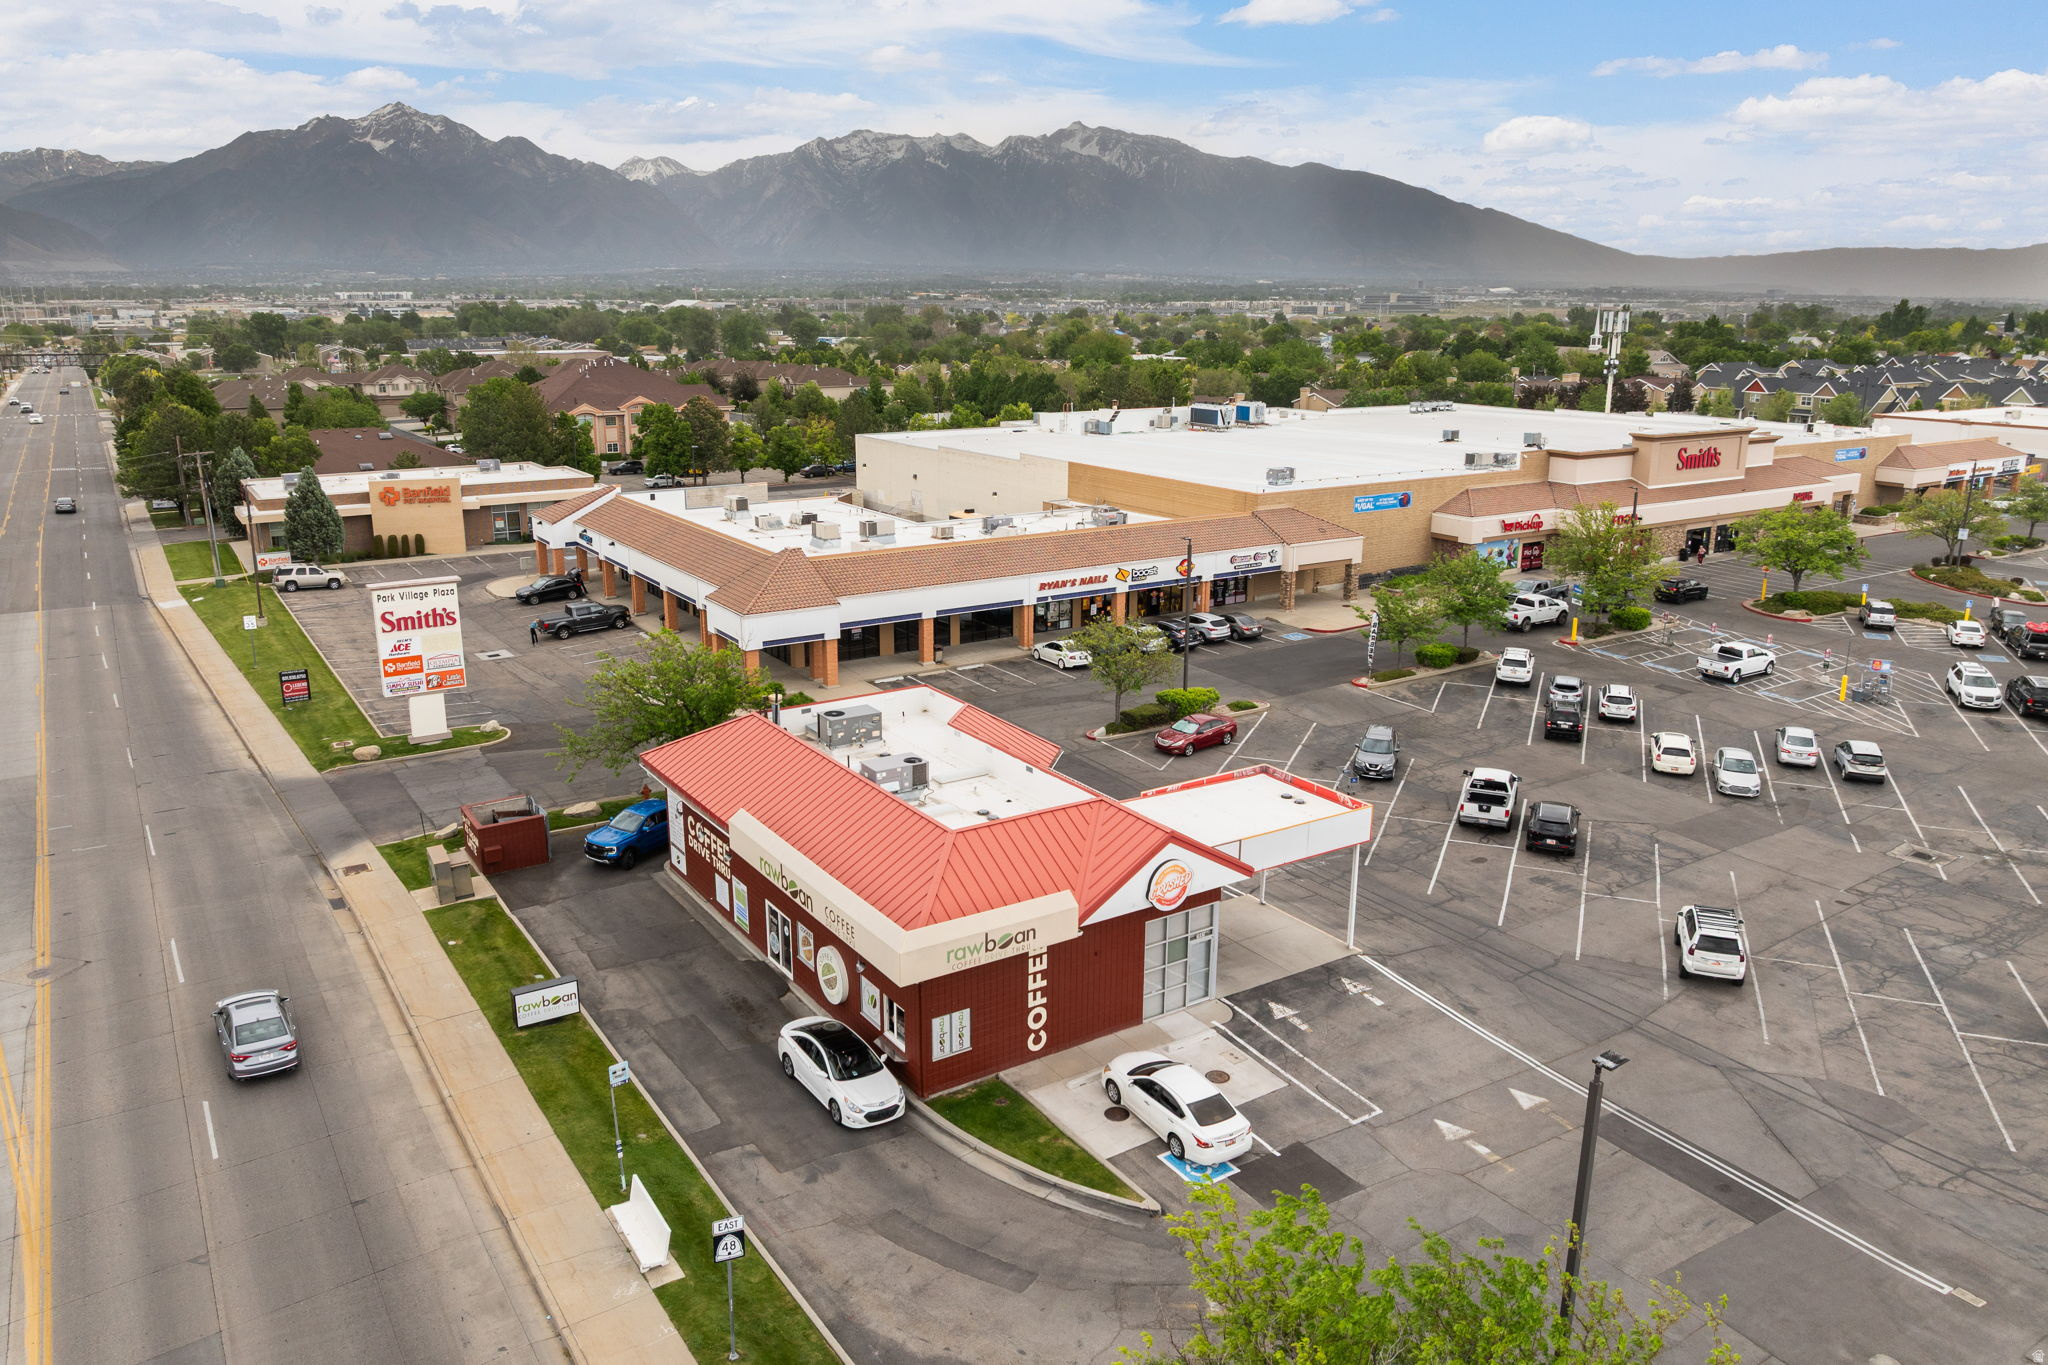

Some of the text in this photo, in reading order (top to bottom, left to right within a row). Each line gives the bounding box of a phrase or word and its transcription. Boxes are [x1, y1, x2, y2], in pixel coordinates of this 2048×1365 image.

[1676, 446, 1722, 471] Smith's
[402, 486, 450, 497] Banfield
[1132, 566, 1159, 577] boost
[1038, 574, 1109, 591] RYAN'S NAILS
[376, 588, 455, 603] Park Village Plaza
[380, 607, 457, 633] Smith's
[390, 643, 411, 653] ACE
[396, 660, 421, 668] Banfield
[687, 815, 731, 866] COFFEE
[688, 834, 731, 880] DRIVE THRU
[824, 906, 855, 940] COFFEE
[952, 944, 1031, 971] COFFEE DRIVE THRU
[518, 1011, 540, 1020] COFFEE
[544, 1005, 560, 1013] DRIVE
[718, 1220, 738, 1231] EAST
[722, 1240, 736, 1251] 48
